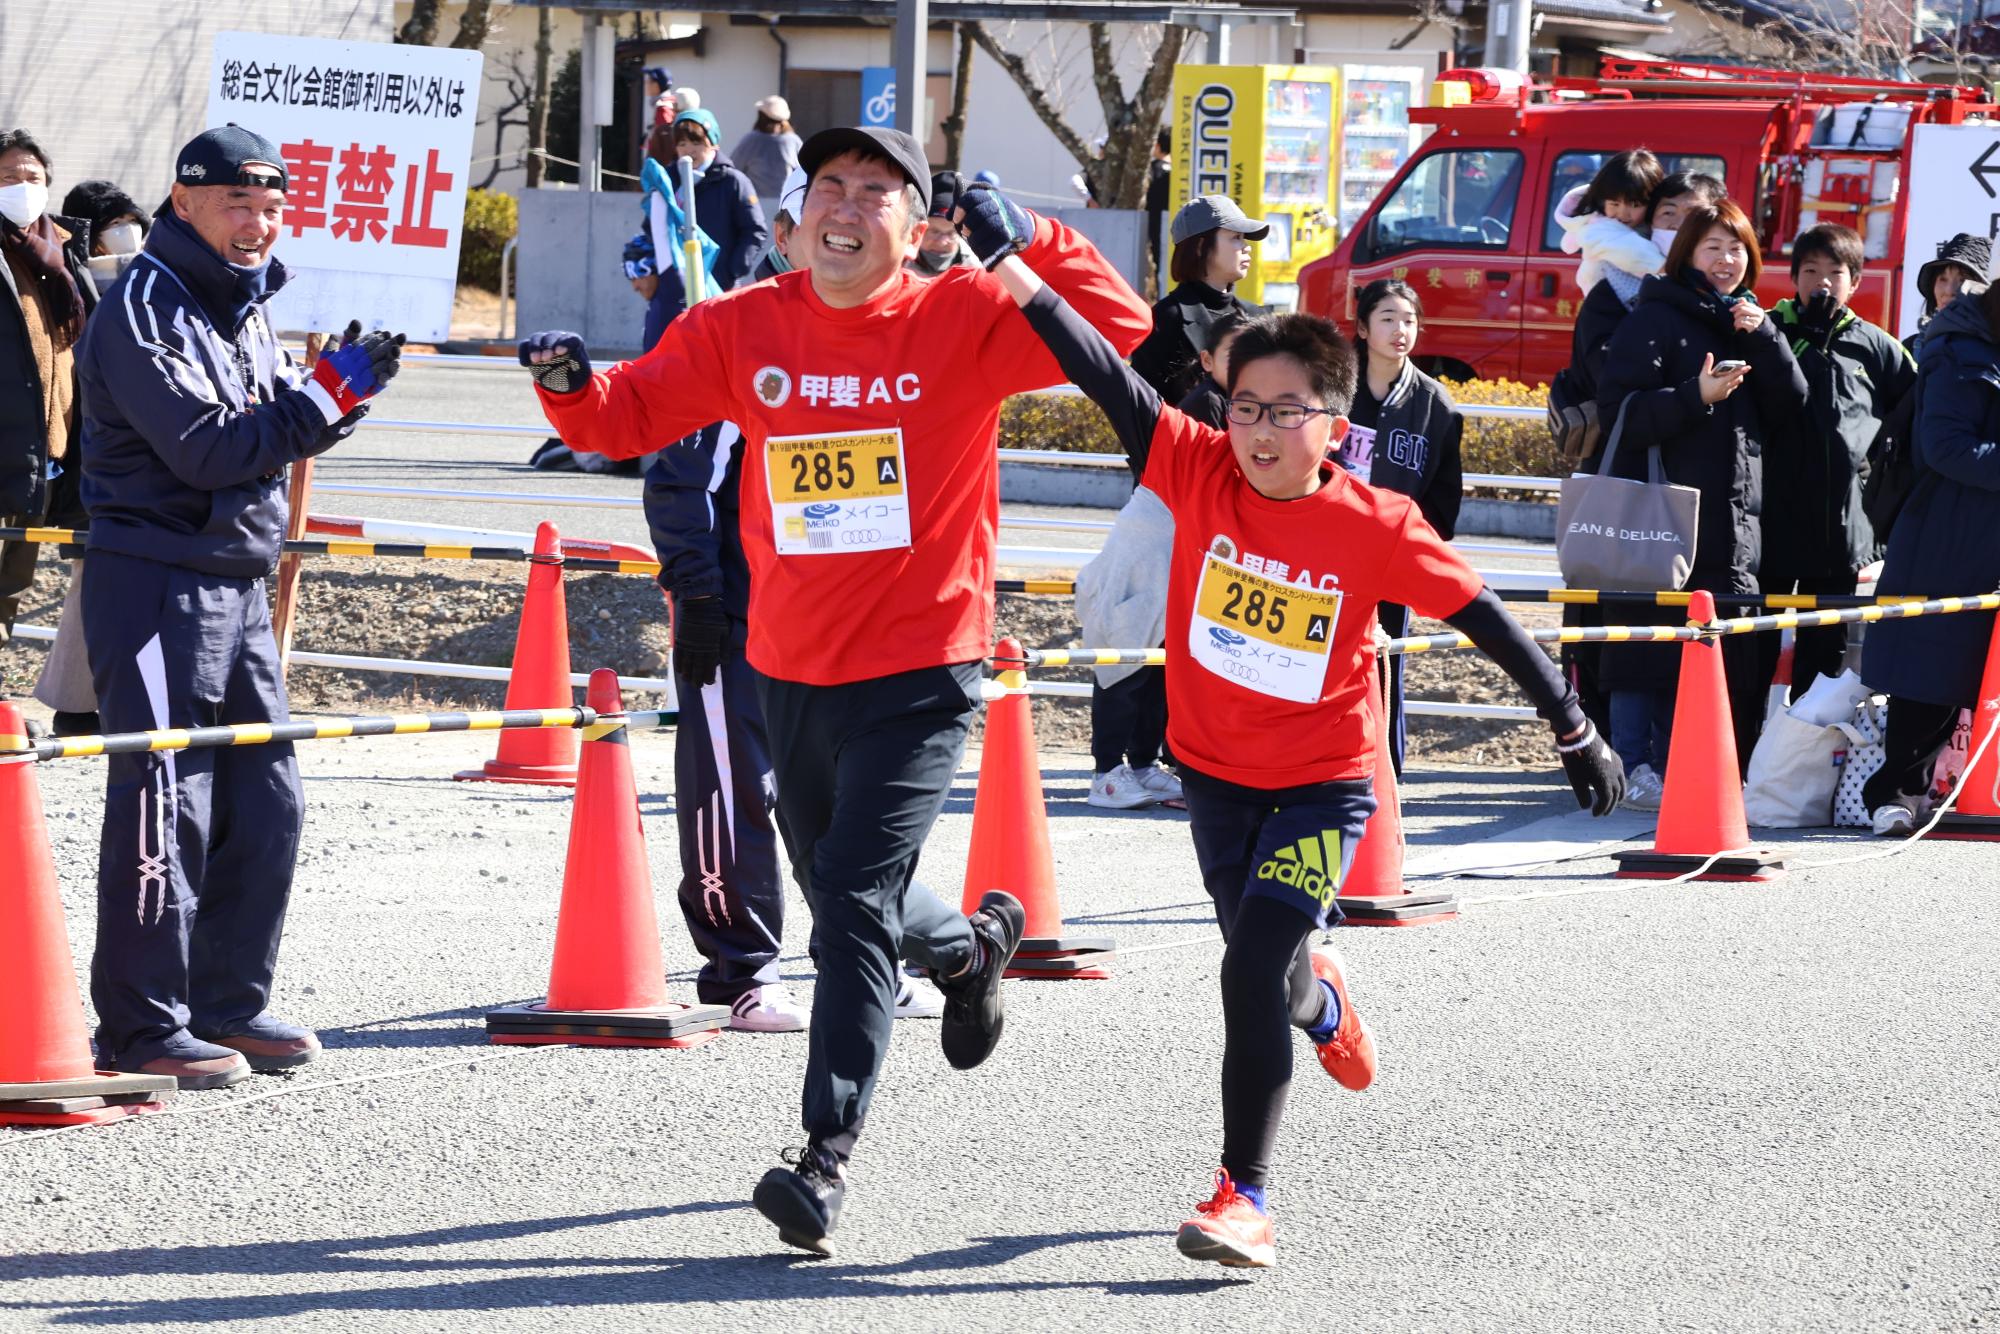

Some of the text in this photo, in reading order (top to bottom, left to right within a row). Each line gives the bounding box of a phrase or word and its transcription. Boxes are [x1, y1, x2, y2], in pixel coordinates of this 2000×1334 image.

[220, 59, 465, 118] 総合文化会館御利用以外は
[791, 451, 896, 493] 285 A
[844, 505, 904, 520] メイコー
[806, 519, 840, 529] MEIKO
[1605, 527, 1615, 538] &
[1222, 581, 1324, 639] 285 A
[1210, 639, 1242, 658] MEIKO
[1247, 647, 1308, 668] メイコー
